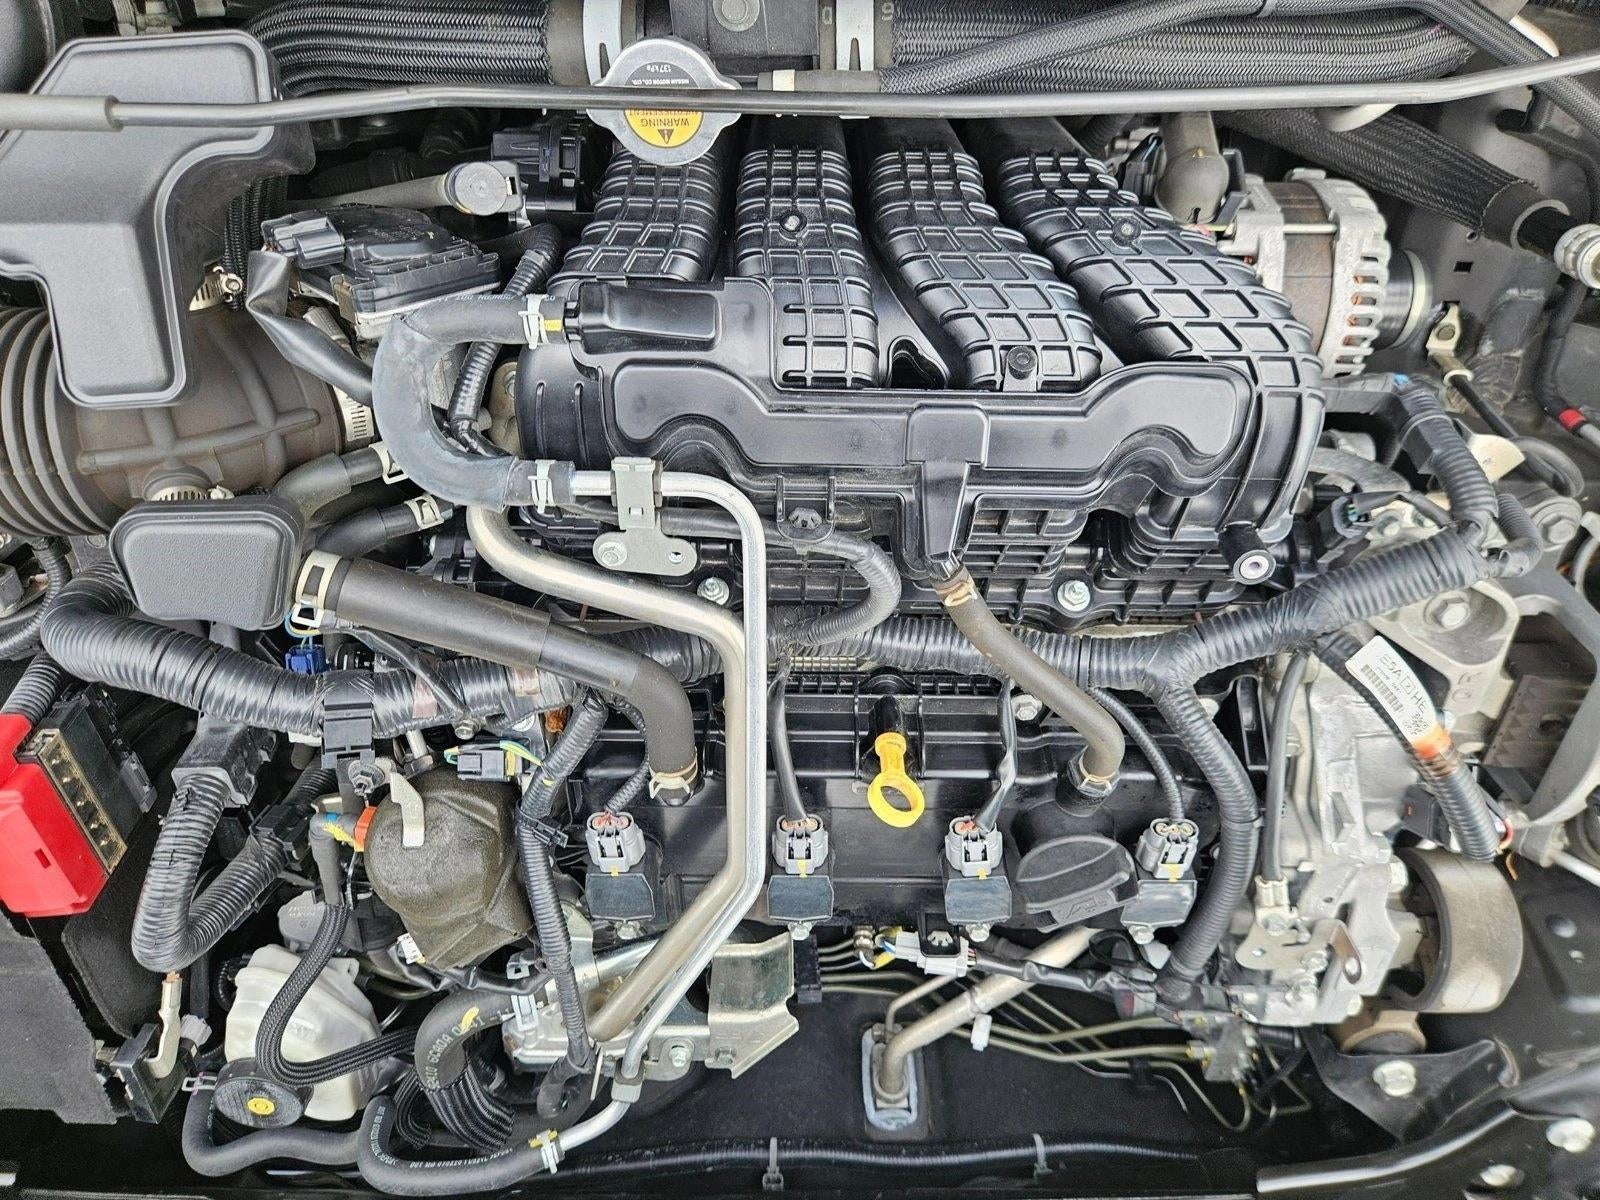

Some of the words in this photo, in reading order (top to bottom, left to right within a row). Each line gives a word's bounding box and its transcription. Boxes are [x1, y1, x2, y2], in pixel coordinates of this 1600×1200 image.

[647, 65, 658, 73] kPa
[660, 65, 671, 73] 137
[640, 118, 690, 127] WARNING
